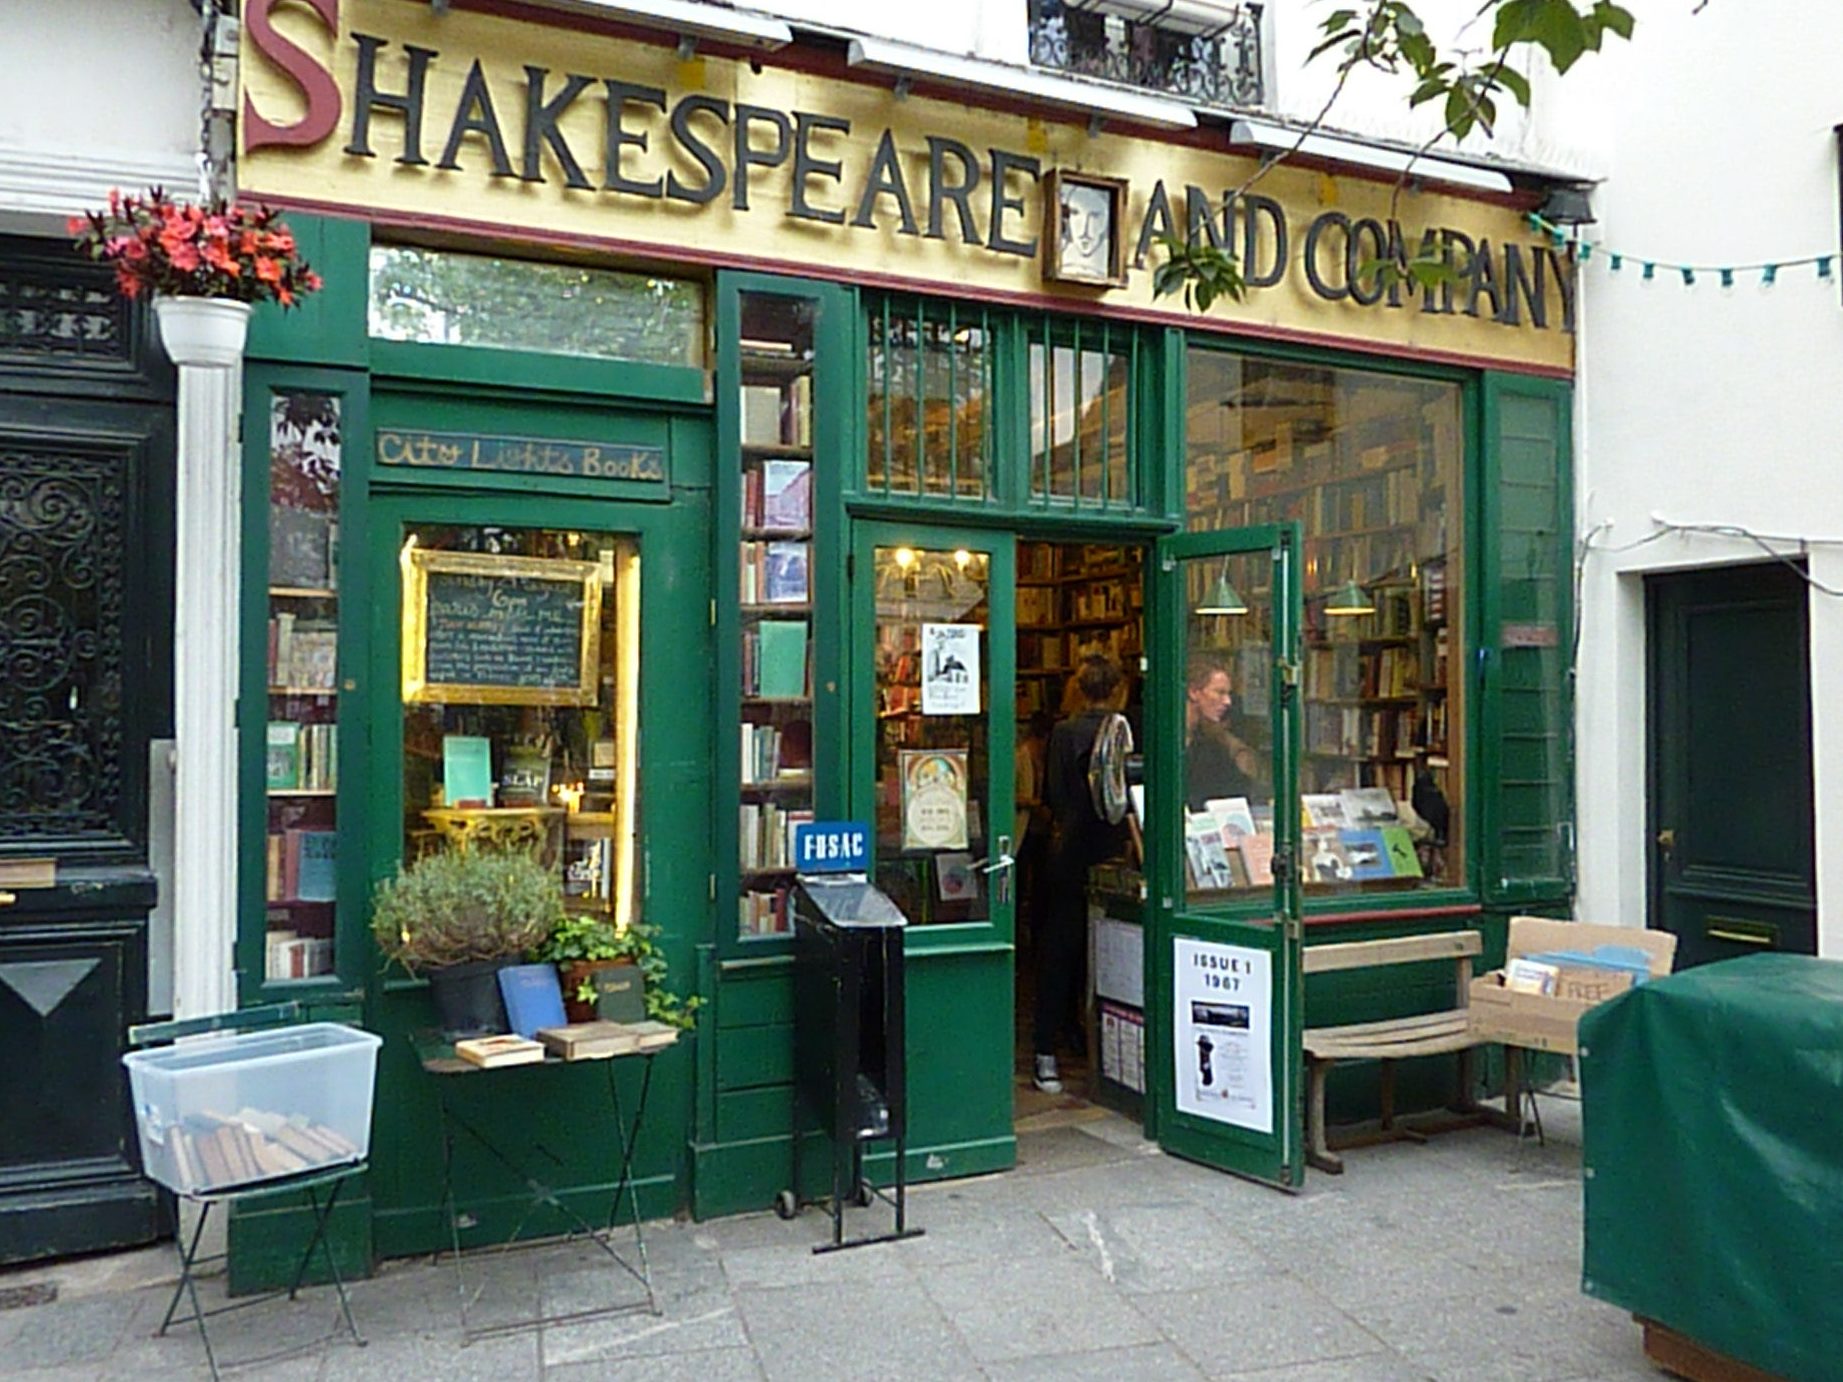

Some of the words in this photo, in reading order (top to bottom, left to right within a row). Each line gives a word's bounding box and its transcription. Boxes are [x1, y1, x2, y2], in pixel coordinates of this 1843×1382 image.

[244, 0, 1040, 257] SHAKESPEARE
[1134, 178, 1289, 288] AND
[1304, 211, 1578, 334] COMPANY
[803, 832, 864, 861] FUSAC
[1193, 952, 1239, 972] ISSUE
[1205, 973, 1241, 991] 1967
